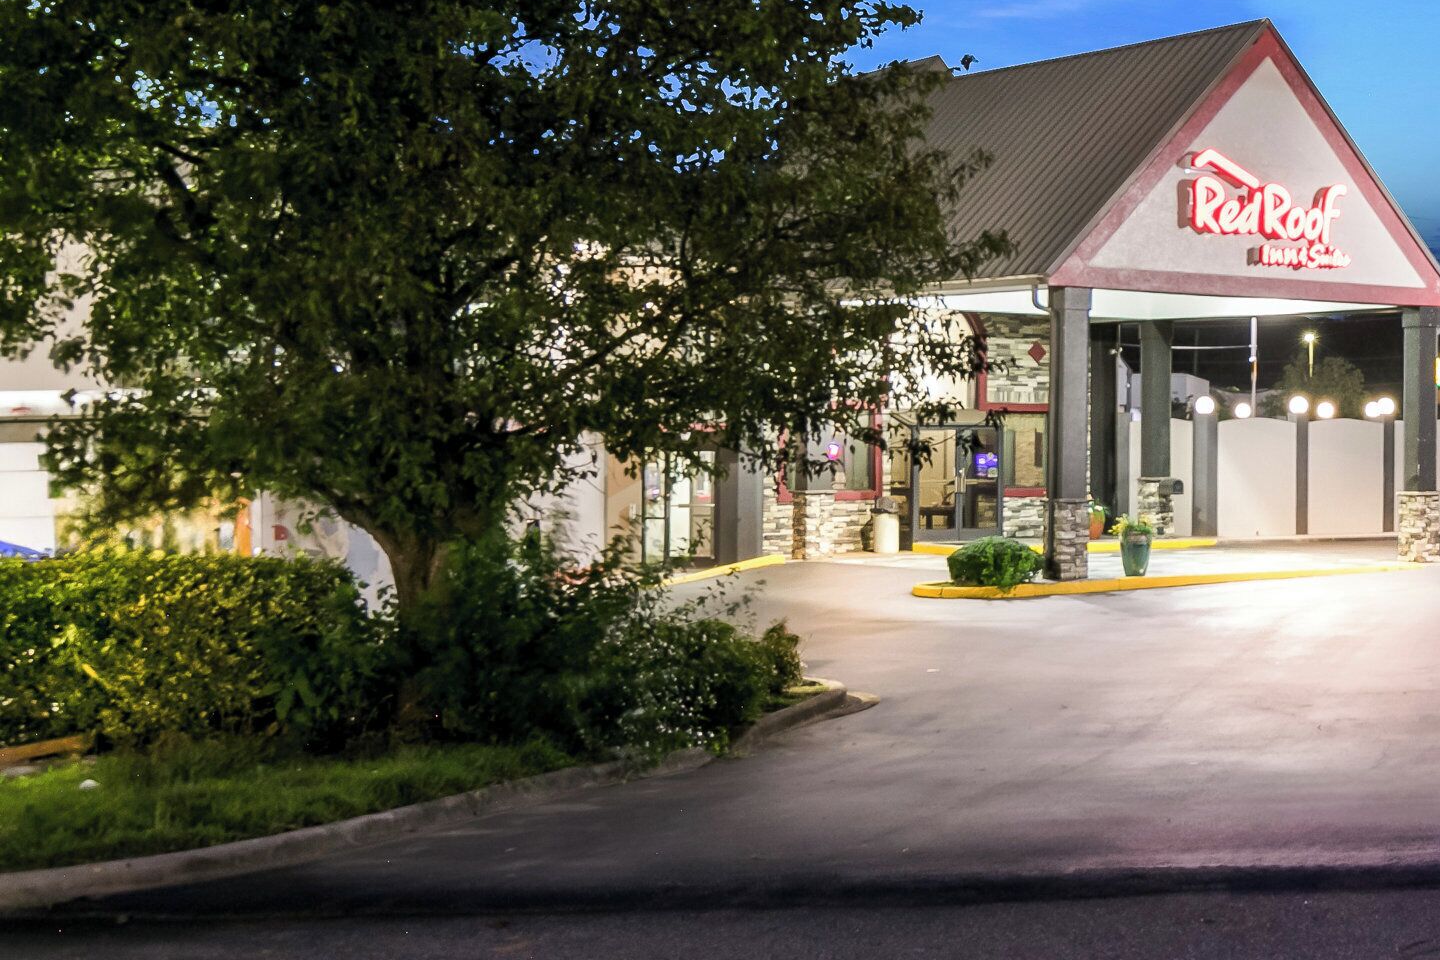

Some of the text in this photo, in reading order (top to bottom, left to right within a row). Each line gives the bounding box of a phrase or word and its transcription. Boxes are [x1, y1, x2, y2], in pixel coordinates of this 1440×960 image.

[1193, 176, 1348, 244] Red Roof
[1261, 244, 1299, 265] Inn
